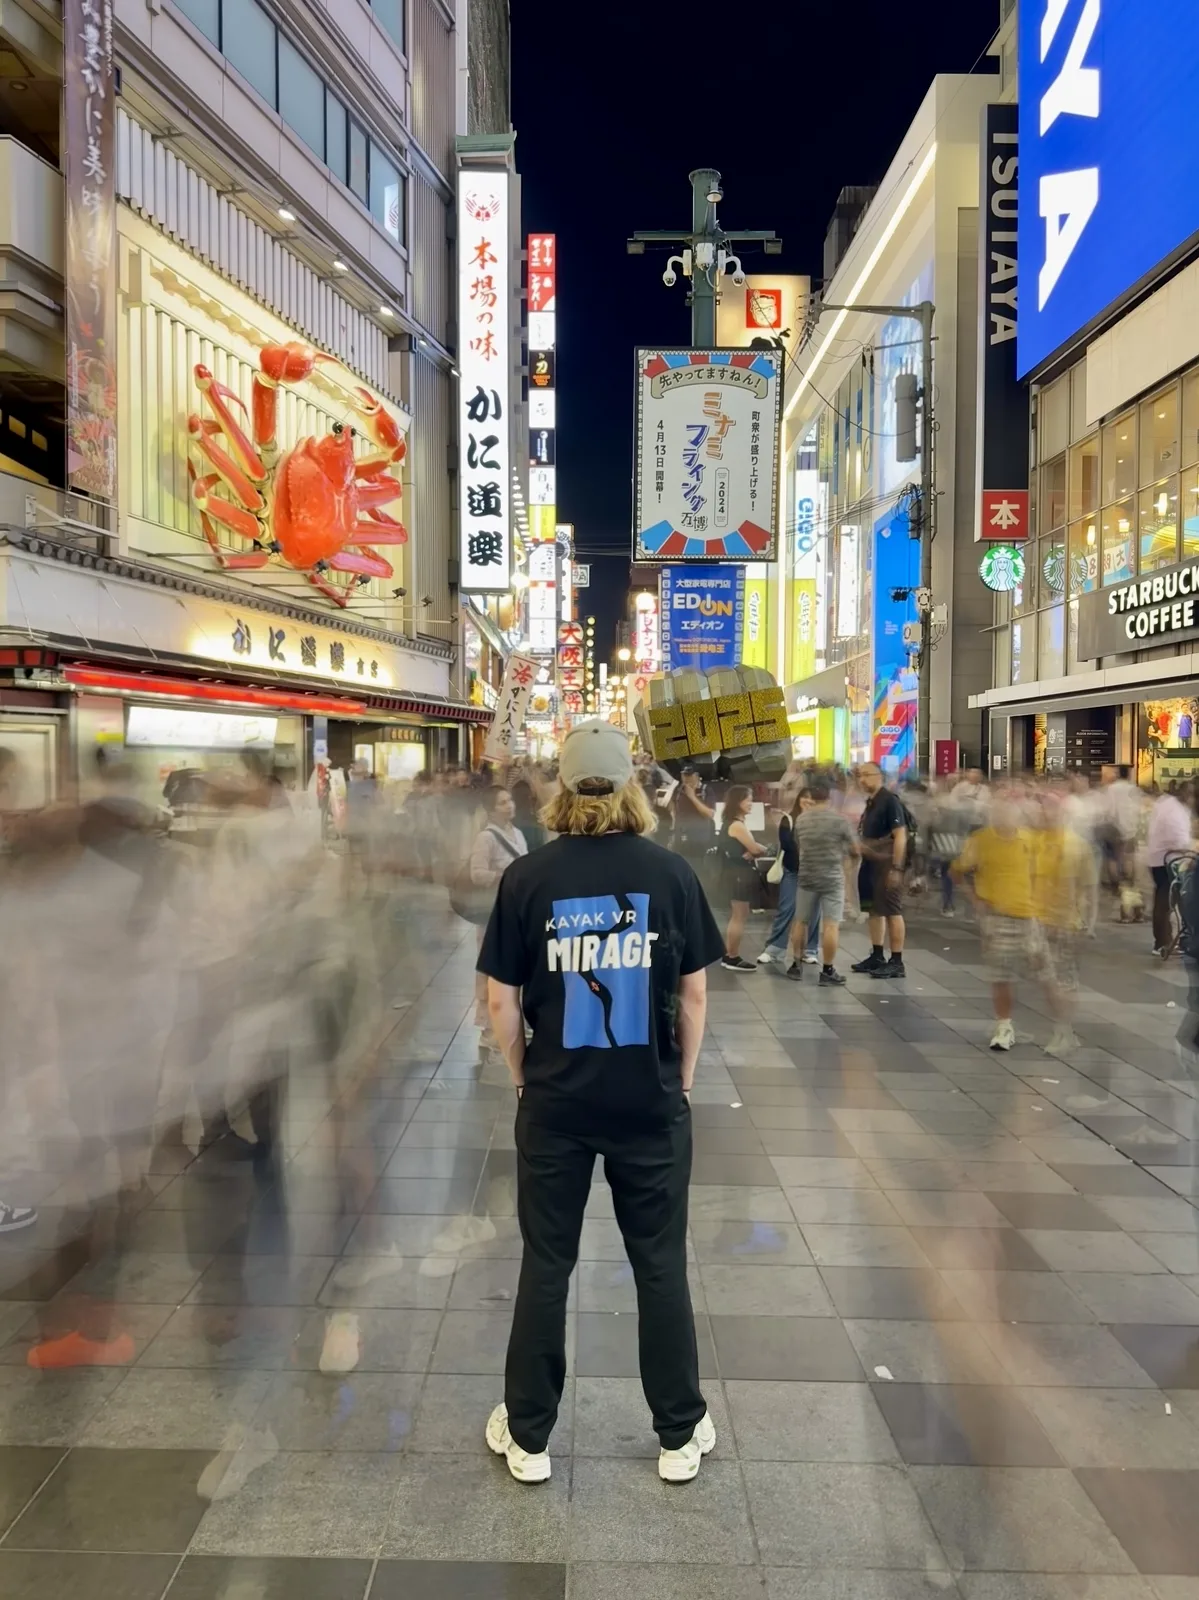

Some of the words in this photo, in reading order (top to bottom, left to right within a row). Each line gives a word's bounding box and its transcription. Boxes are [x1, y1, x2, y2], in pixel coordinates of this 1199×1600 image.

[468, 236, 498, 362] 本場の味
[659, 367, 761, 388] 先やってますねん！
[702, 391, 737, 460] ミナミ
[465, 385, 503, 566] かに道楽
[654, 419, 667, 504] 4月13日開幕！
[749, 410, 760, 512] 町衆が盛り上げる！
[718, 481, 726, 514] 2024
[989, 499, 1020, 529] 本
[673, 593, 733, 617] EDION
[681, 620, 724, 631] エディオン
[1125, 600, 1194, 639] COFFEE
[560, 624, 584, 713] 大阪王将
[648, 686, 791, 761] 2025
[545, 911, 605, 932] KAYAK
[612, 910, 637, 924] VR
[546, 931, 660, 973] MIRAGE
